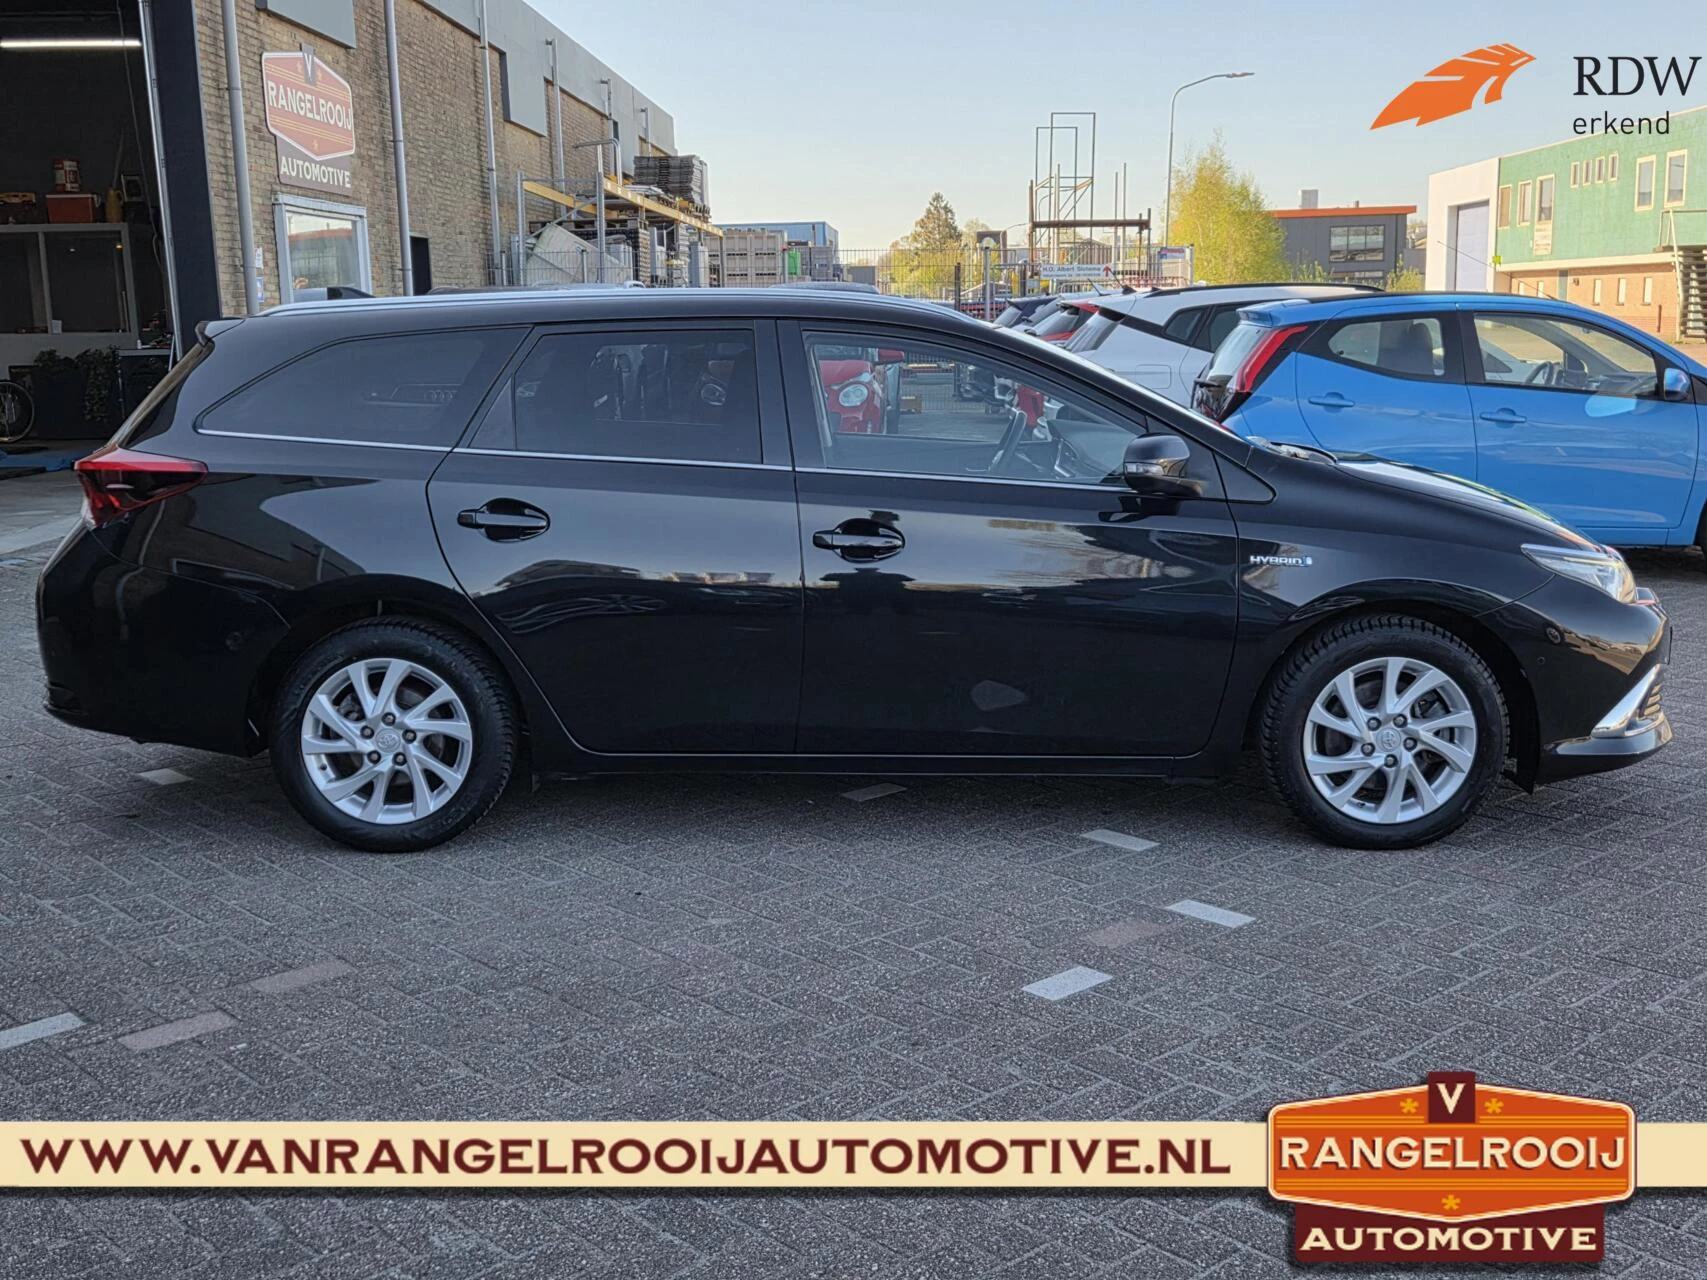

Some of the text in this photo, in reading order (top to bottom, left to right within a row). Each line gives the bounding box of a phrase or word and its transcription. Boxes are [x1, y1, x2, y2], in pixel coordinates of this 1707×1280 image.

[304, 53, 313, 80] V
[267, 80, 352, 131] RANGELROOIJ
[280, 156, 351, 188] AUTOMOTIVE
[1249, 555, 1303, 565] HYBRID
